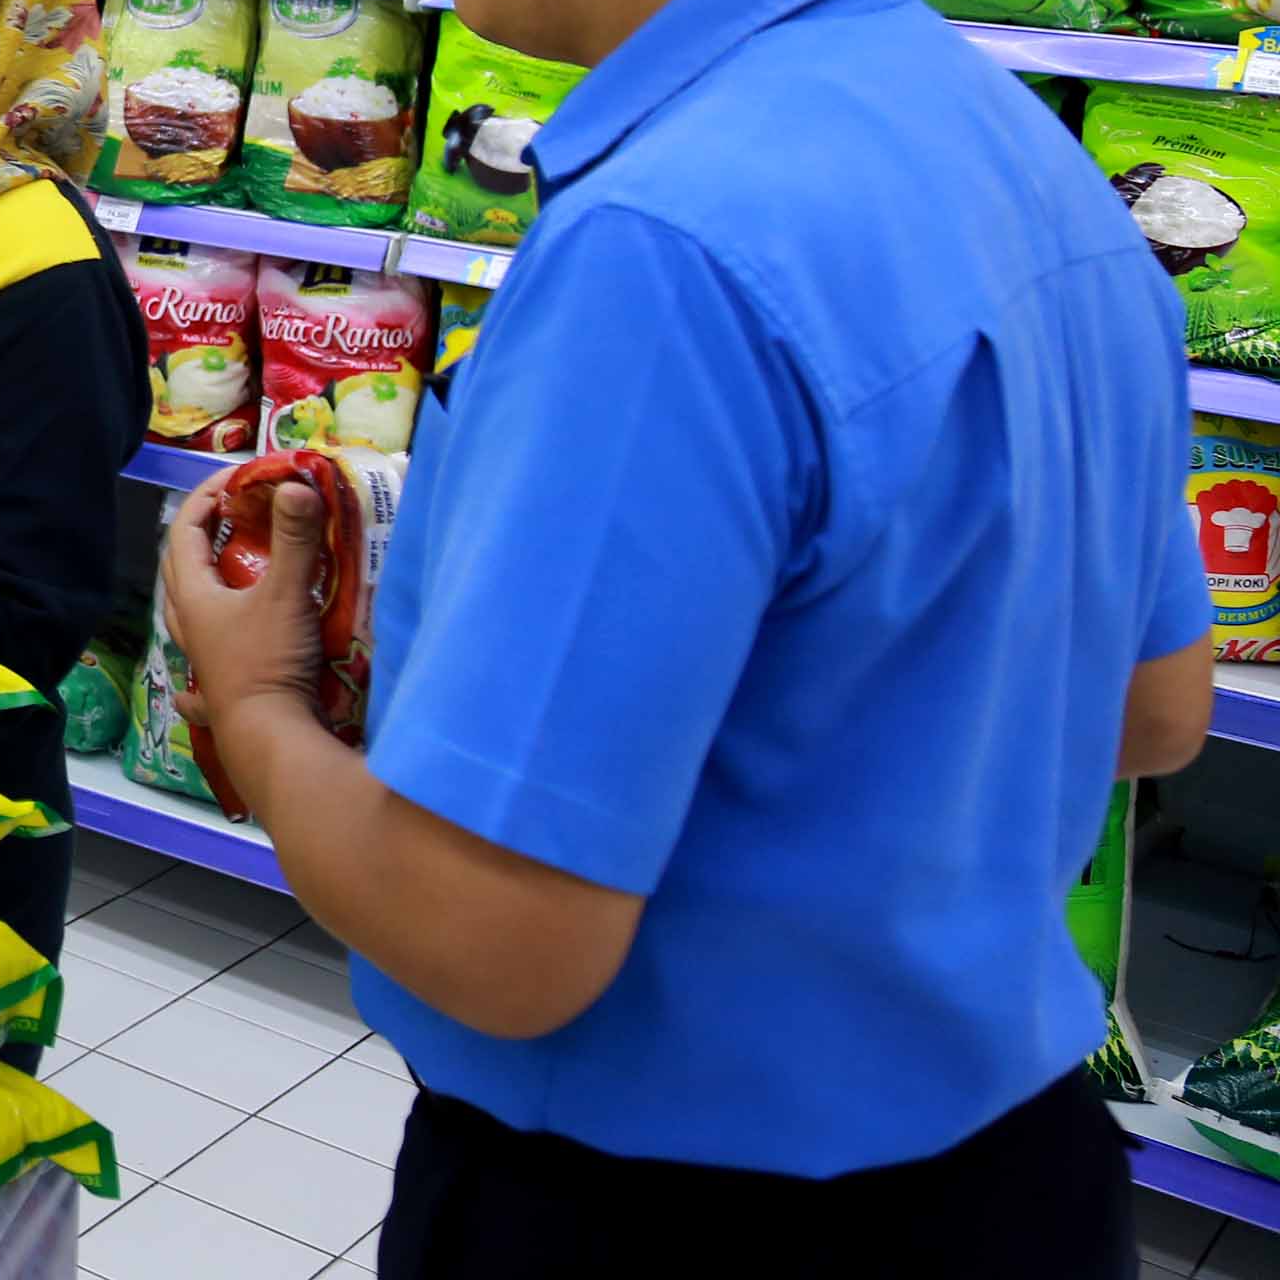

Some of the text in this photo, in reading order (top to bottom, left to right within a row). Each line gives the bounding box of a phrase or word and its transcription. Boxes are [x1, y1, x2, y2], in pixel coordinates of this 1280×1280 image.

[1152, 134, 1228, 161] Premium
[145, 286, 246, 328] Ramos
[311, 312, 414, 355] Ramos
[1233, 577, 1265, 590] KOKI
